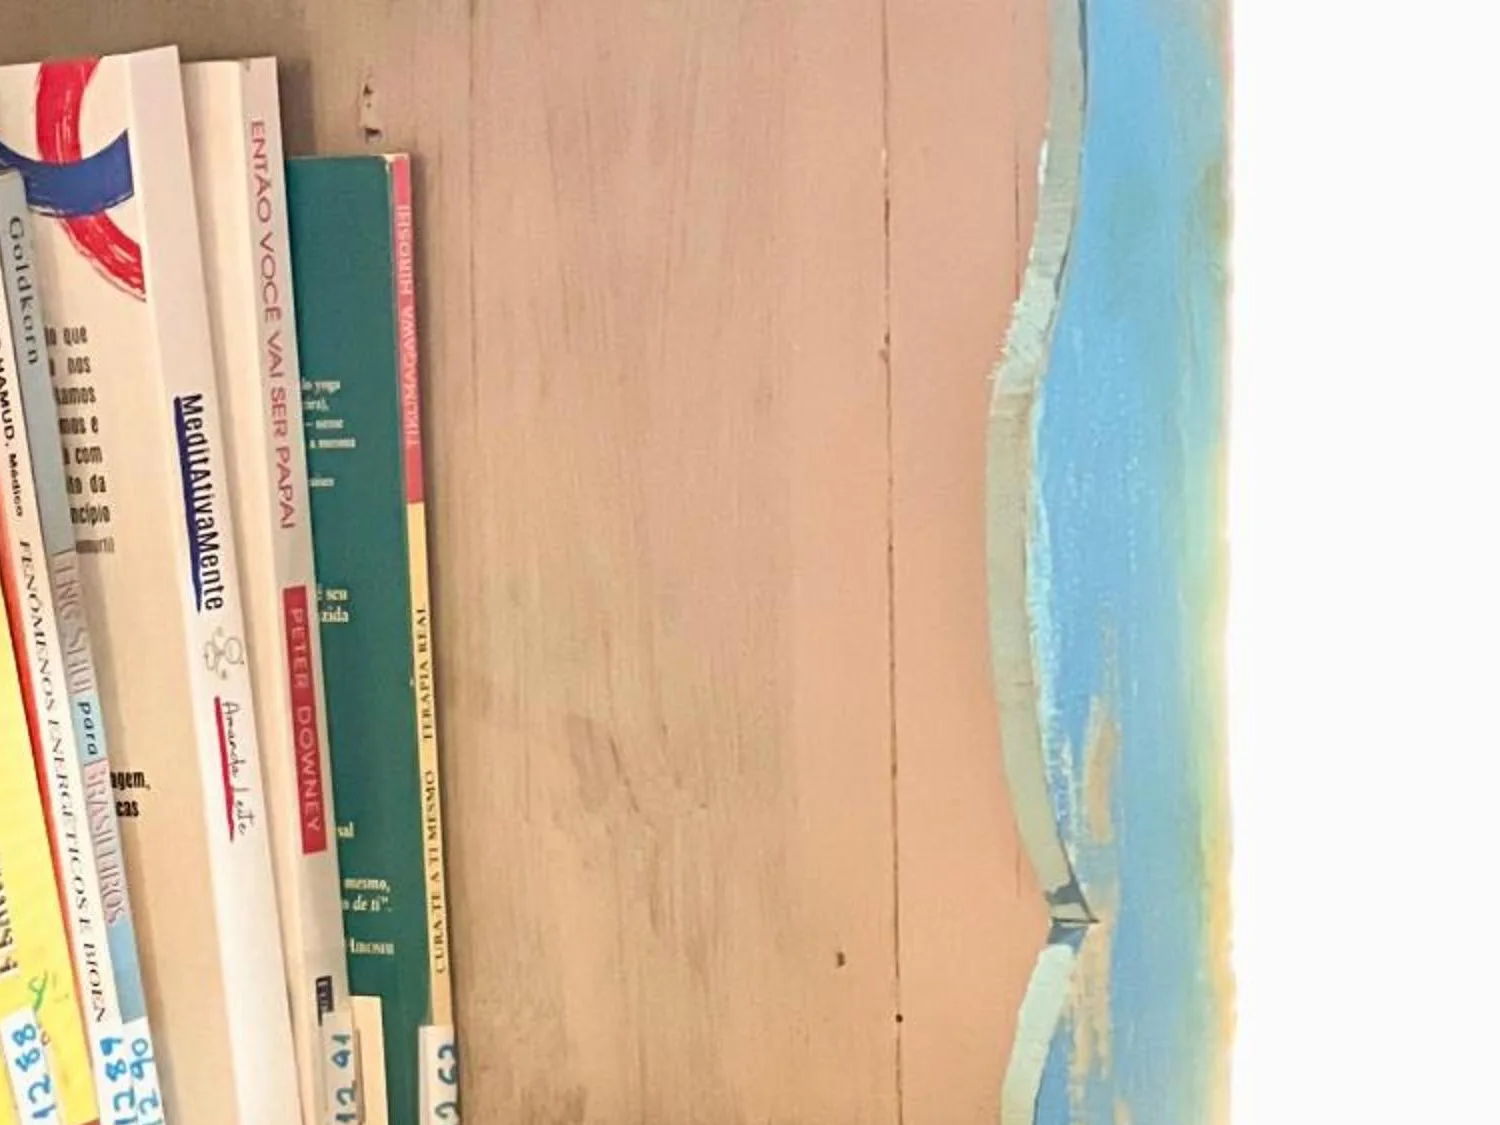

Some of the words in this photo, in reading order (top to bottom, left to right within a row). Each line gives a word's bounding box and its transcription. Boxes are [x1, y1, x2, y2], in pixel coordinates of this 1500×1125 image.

[251, 119, 271, 224] ENTÃO
[7, 216, 39, 365] Goldkorn
[259, 231, 282, 324] VOCÊ
[62, 326, 88, 346] que
[67, 357, 91, 374] nos
[267, 331, 285, 378] VAI
[271, 386, 288, 438] SER
[74, 446, 102, 464] com
[89, 474, 106, 493] da
[276, 449, 297, 530] PAPAI
[182, 393, 224, 611] MeditAtivaMente
[18, 539, 56, 716] FENÔMENOS
[78, 700, 98, 756] para
[290, 606, 310, 690] PETER
[300, 706, 325, 835] DOWNEY
[222, 700, 240, 780] Amanda
[236, 786, 257, 838] Leite
